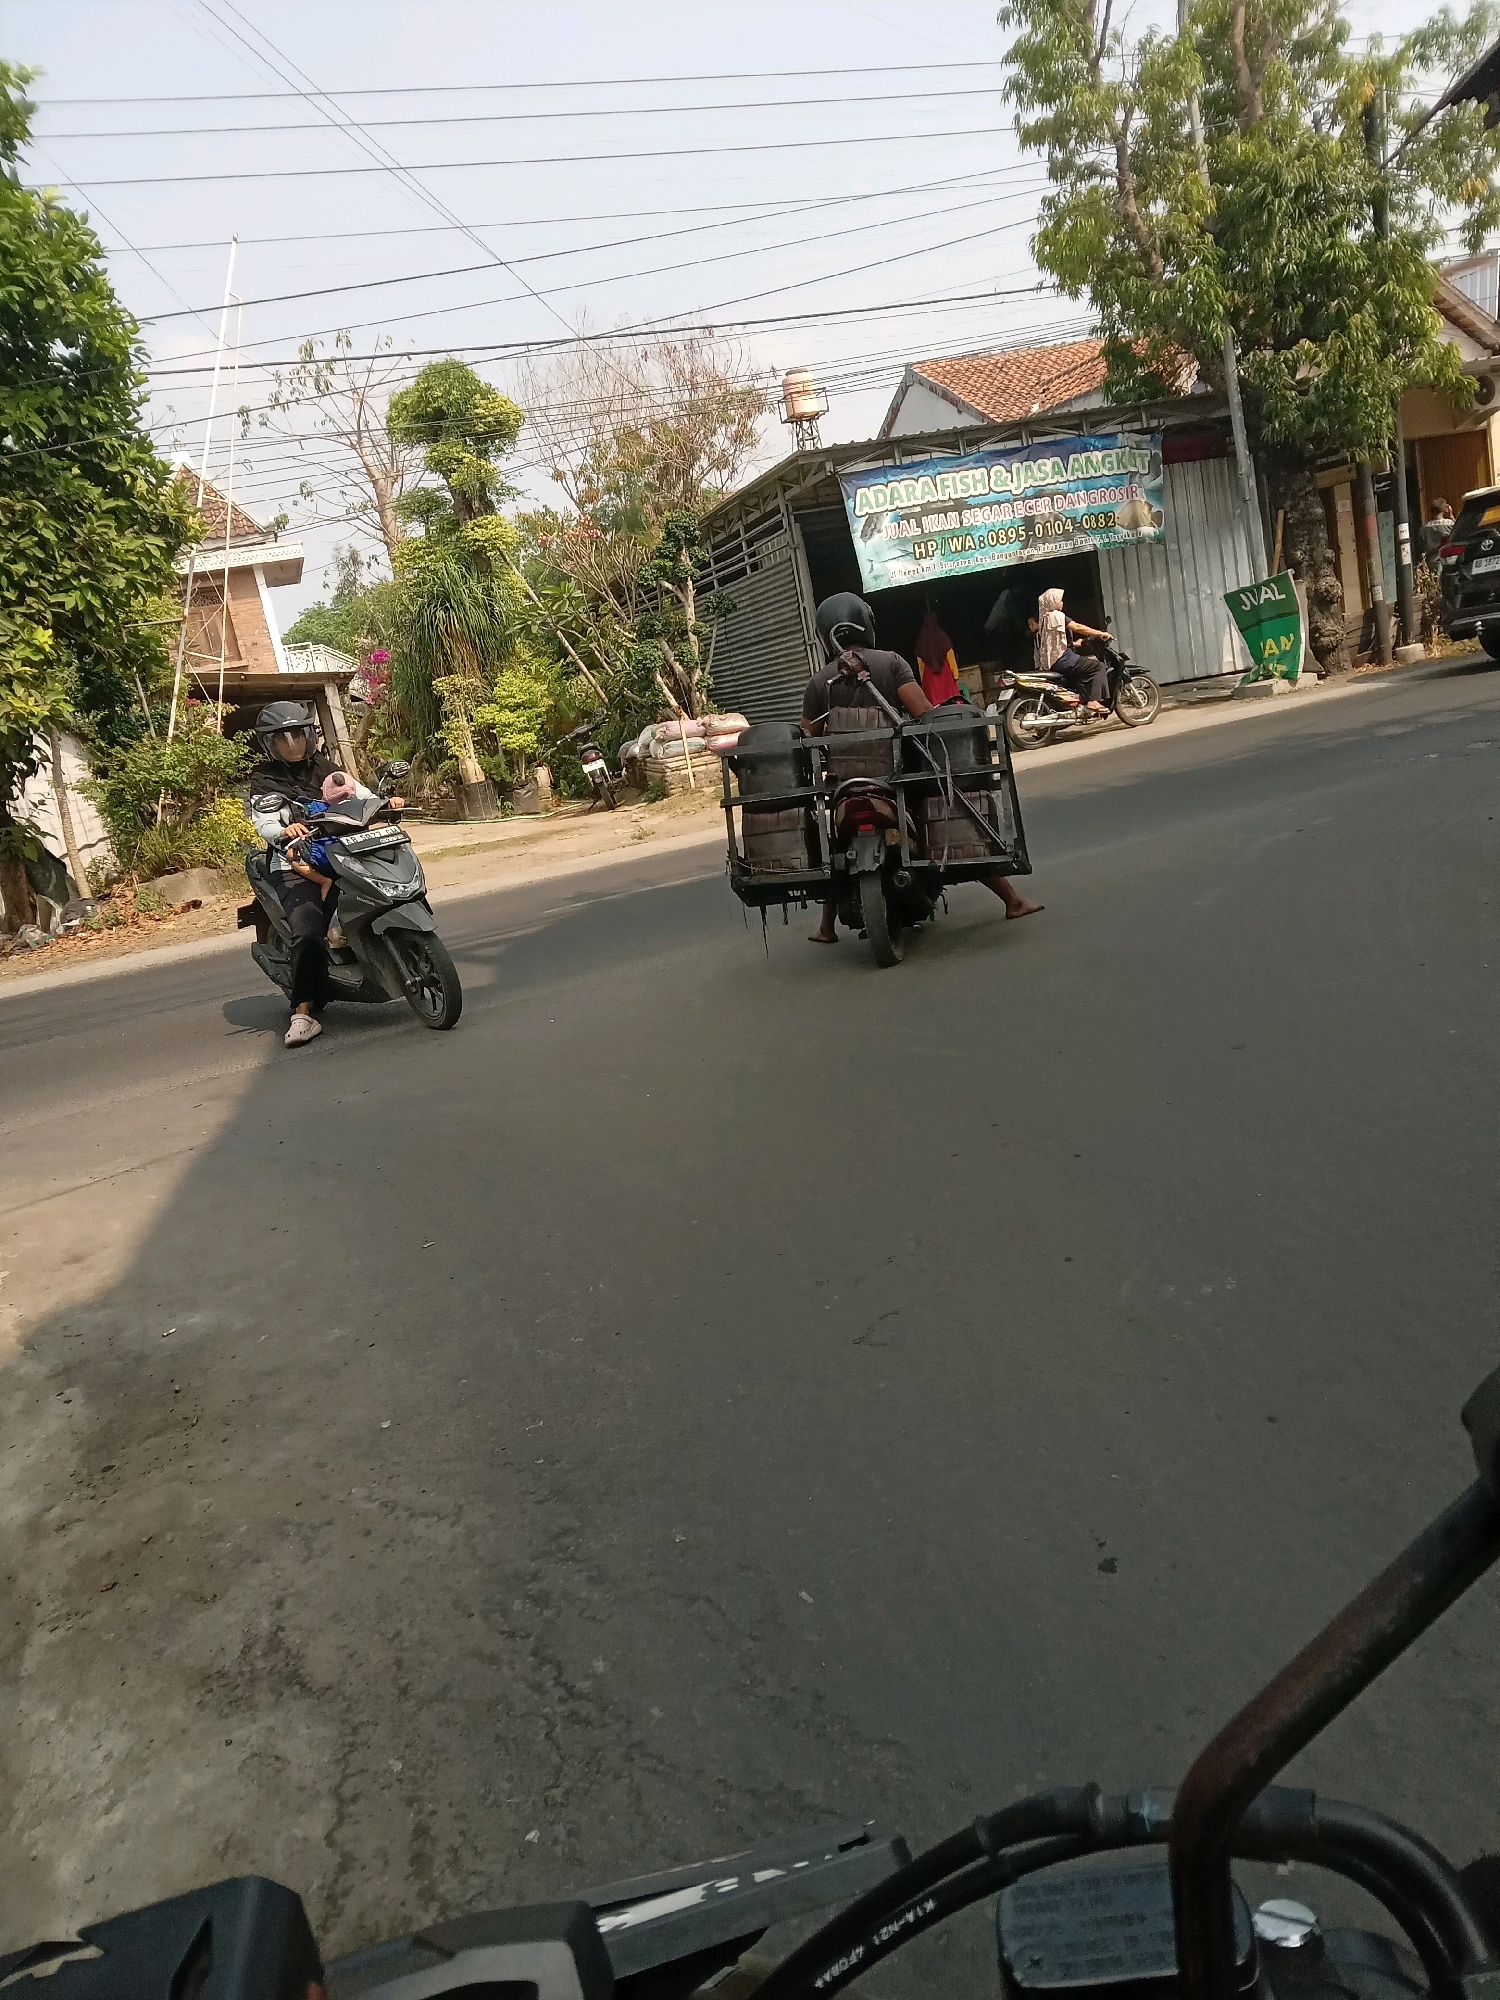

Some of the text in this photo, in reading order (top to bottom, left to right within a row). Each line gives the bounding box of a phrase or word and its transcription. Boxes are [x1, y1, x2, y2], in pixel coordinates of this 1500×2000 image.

[856, 478, 938, 513] ADARA
[938, 470, 988, 498] FISH
[993, 468, 1010, 489] &
[1013, 458, 1067, 491] JASA
[883, 519, 921, 540] JUAL
[922, 511, 960, 534] IKAN
[962, 502, 1012, 527] SEGAR
[1015, 498, 1052, 518] ECER
